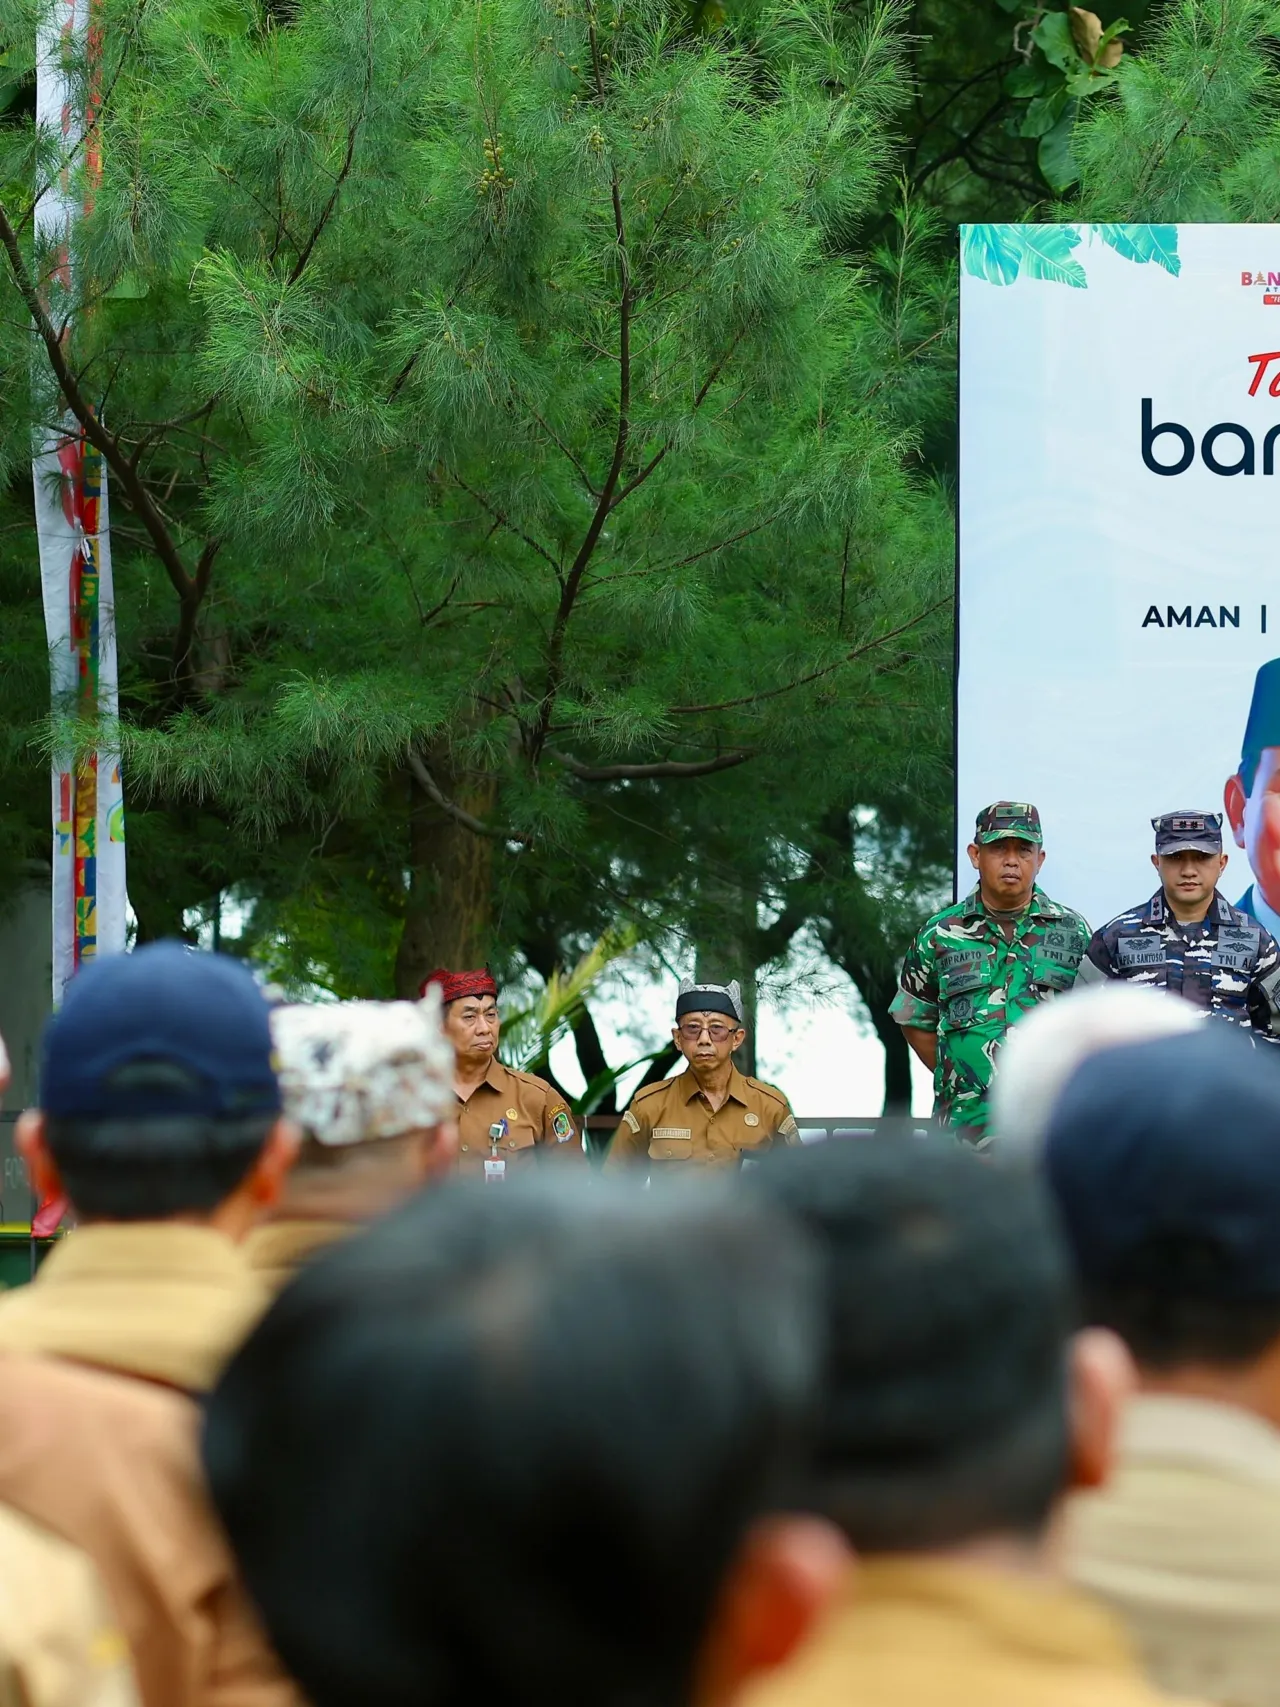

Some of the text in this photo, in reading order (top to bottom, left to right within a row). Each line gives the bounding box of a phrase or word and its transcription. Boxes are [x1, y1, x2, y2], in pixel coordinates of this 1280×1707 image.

[1141, 605, 1241, 629] AMAN
[1042, 949, 1063, 961] TNI
[1136, 952, 1164, 964] SANTOSO
[1218, 954, 1237, 966] TNI
